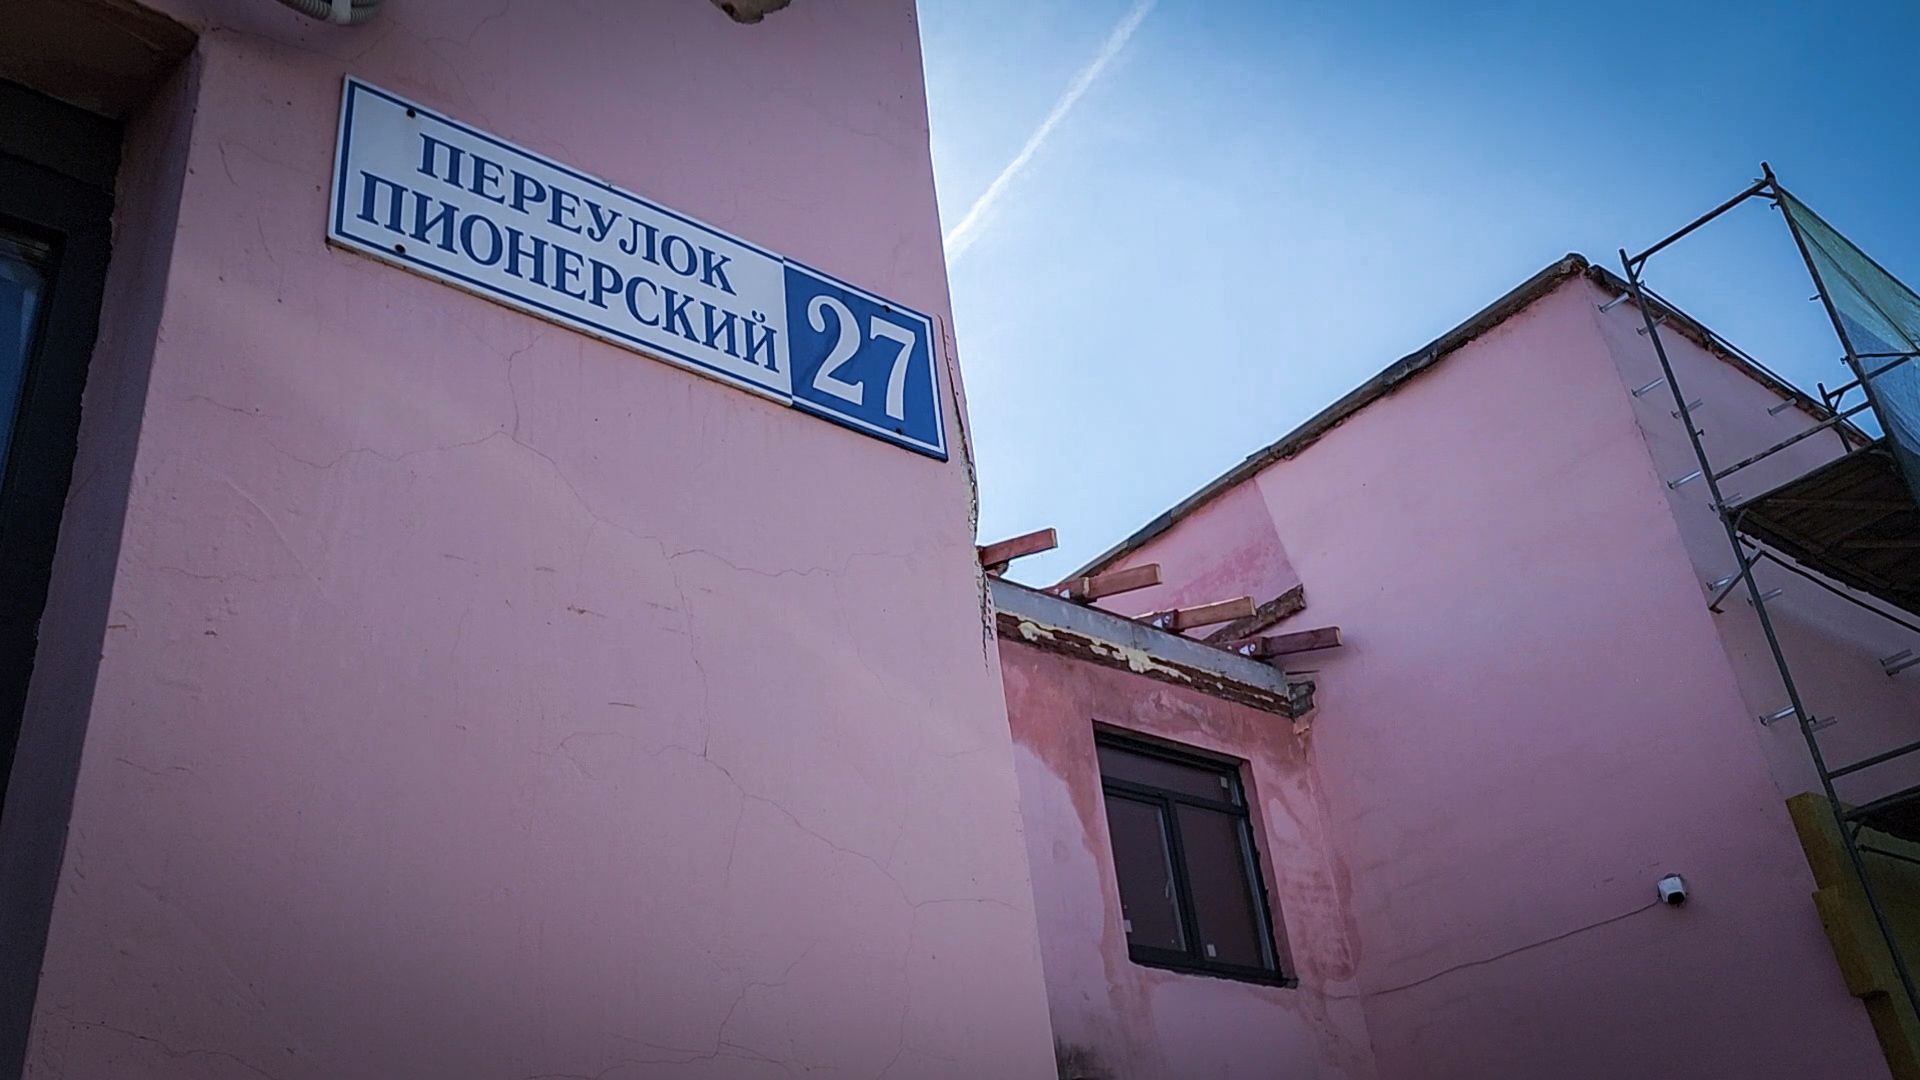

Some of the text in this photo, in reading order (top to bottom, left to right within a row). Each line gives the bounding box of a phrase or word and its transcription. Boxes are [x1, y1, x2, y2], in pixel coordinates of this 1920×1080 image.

[356, 168, 781, 374] ПИОНЕРСКИЙ
[416, 132, 738, 297] ПЕРЕУЛОК
[807, 294, 916, 422] 27
